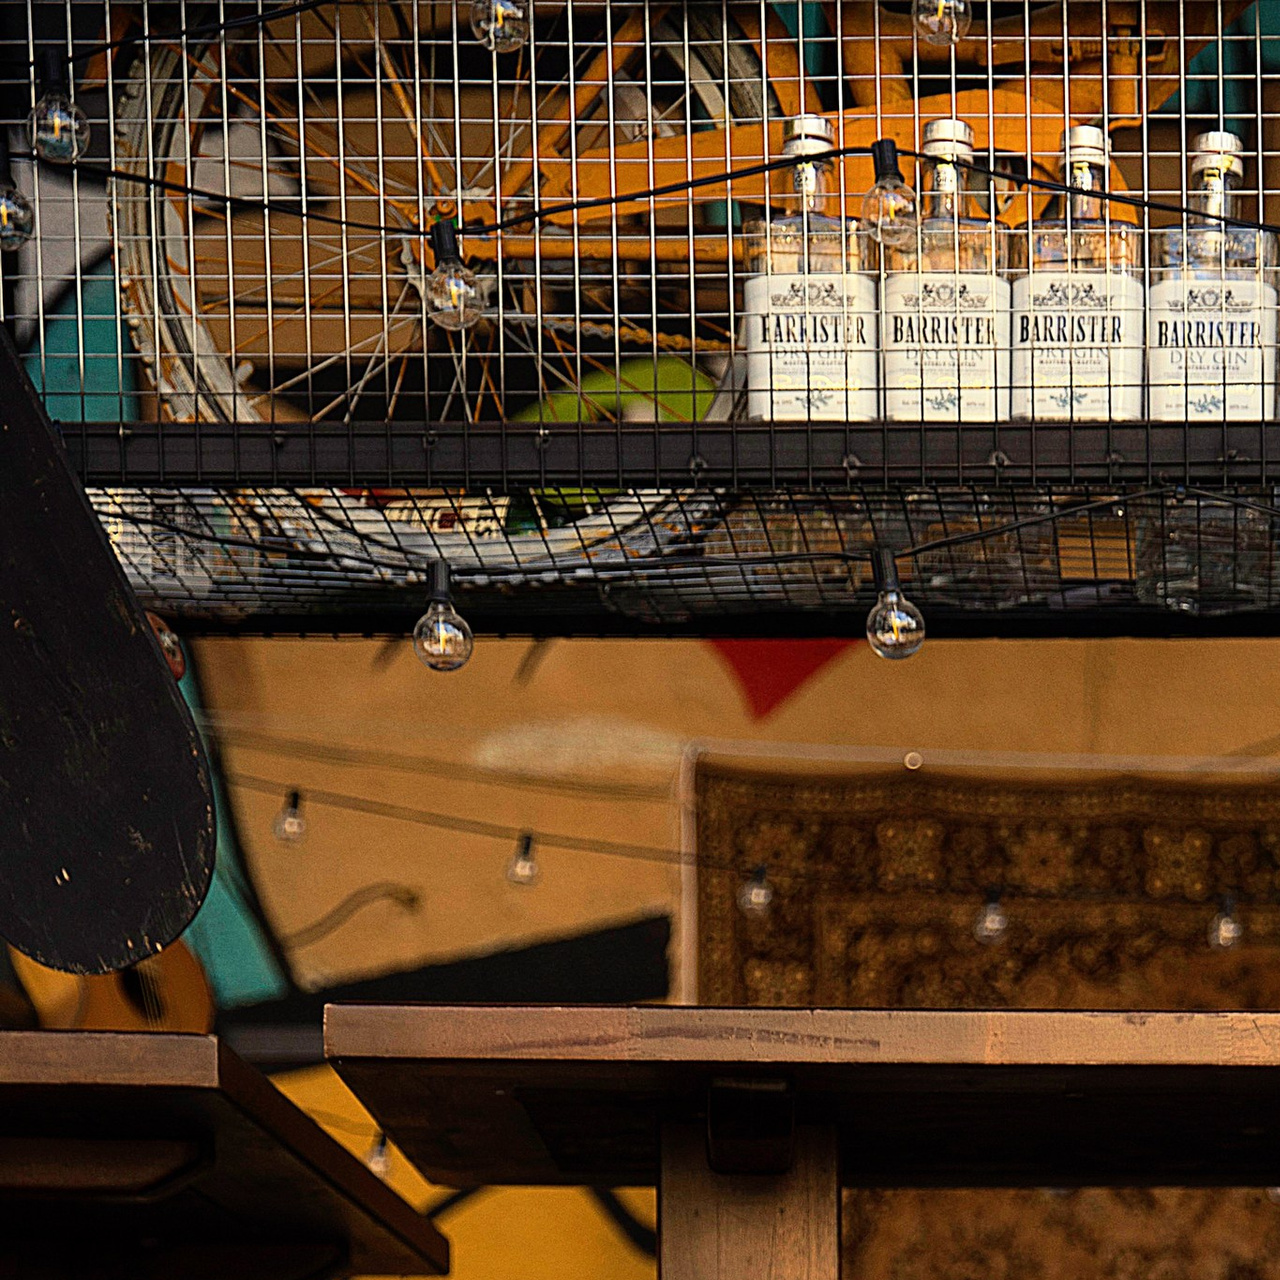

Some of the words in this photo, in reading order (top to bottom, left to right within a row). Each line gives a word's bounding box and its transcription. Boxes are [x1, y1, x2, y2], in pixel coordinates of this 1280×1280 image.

[893, 315, 996, 344] BARRISTER
[1020, 315, 1122, 343] BARRISTER
[1158, 321, 1261, 347] BARRISTER
[1170, 350, 1205, 364] DRY
[1213, 350, 1247, 364] GIN
